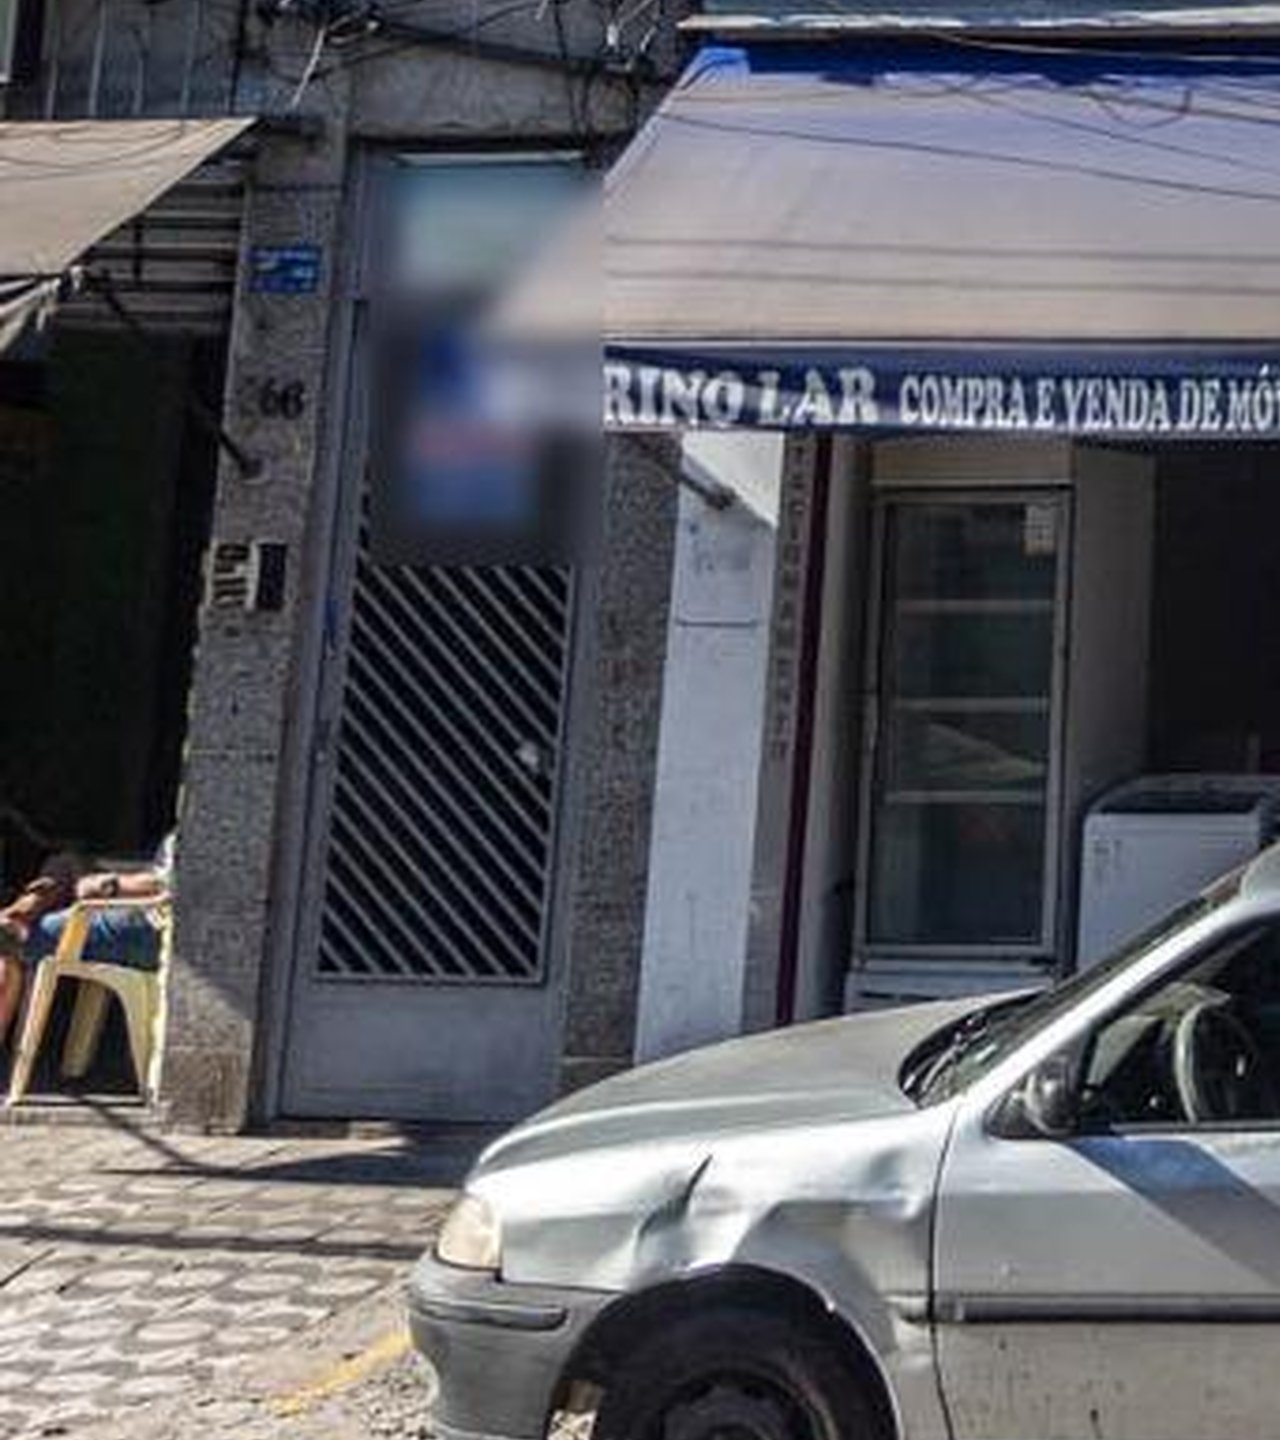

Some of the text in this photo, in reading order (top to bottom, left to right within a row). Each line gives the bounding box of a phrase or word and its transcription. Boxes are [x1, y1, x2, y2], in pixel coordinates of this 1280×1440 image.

[759, 367, 880, 425] LAR
[901, 375, 1028, 428] COMPRA
[1034, 378, 1056, 429] E
[1061, 378, 1170, 432] VENDA
[1178, 379, 1222, 431] DE
